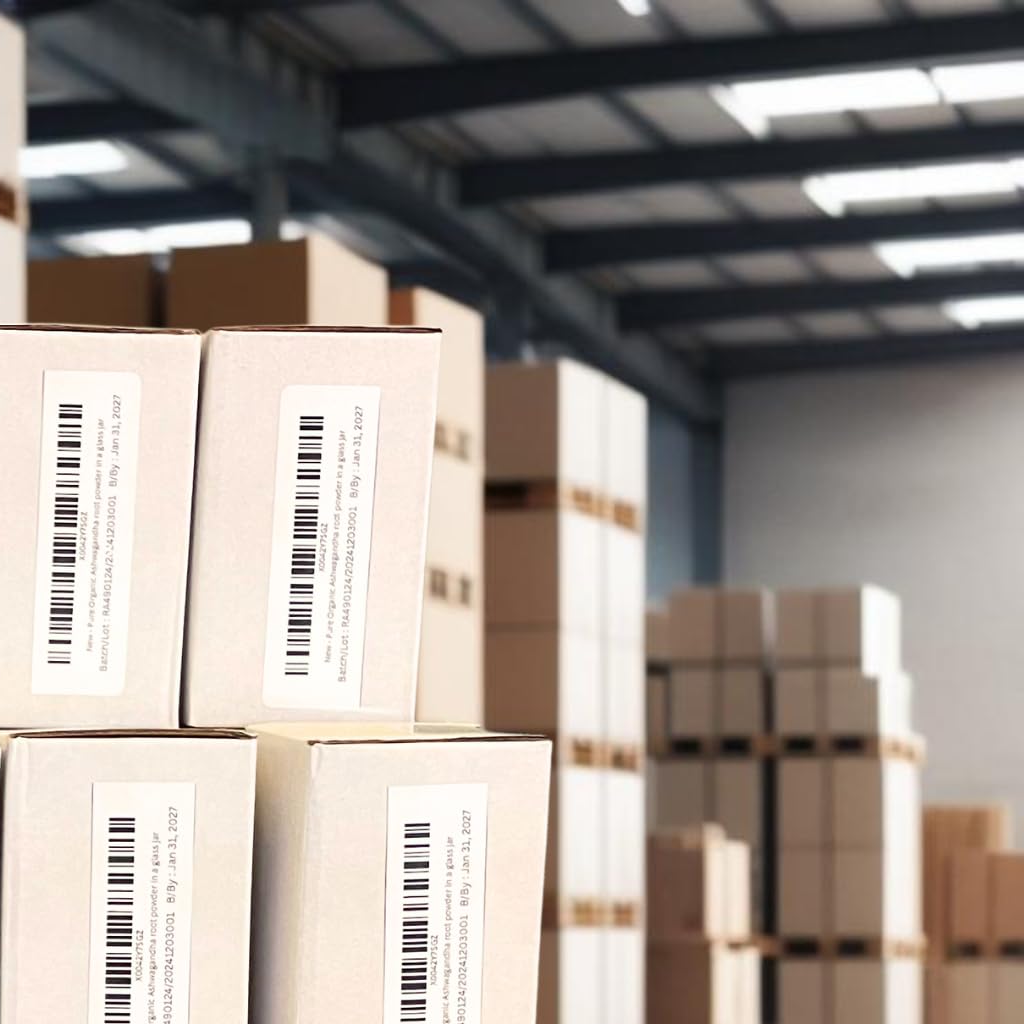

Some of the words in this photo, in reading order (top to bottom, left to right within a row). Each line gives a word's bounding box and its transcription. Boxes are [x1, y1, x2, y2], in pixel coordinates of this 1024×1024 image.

[353, 405, 363, 430] 2027
[352, 449, 360, 467] Jan
[349, 474, 361, 498] B/By
[337, 635, 349, 682] Batch/Lot
[461, 809, 471, 835] 2027
[461, 855, 470, 874] Jan
[460, 882, 472, 906] B/By
